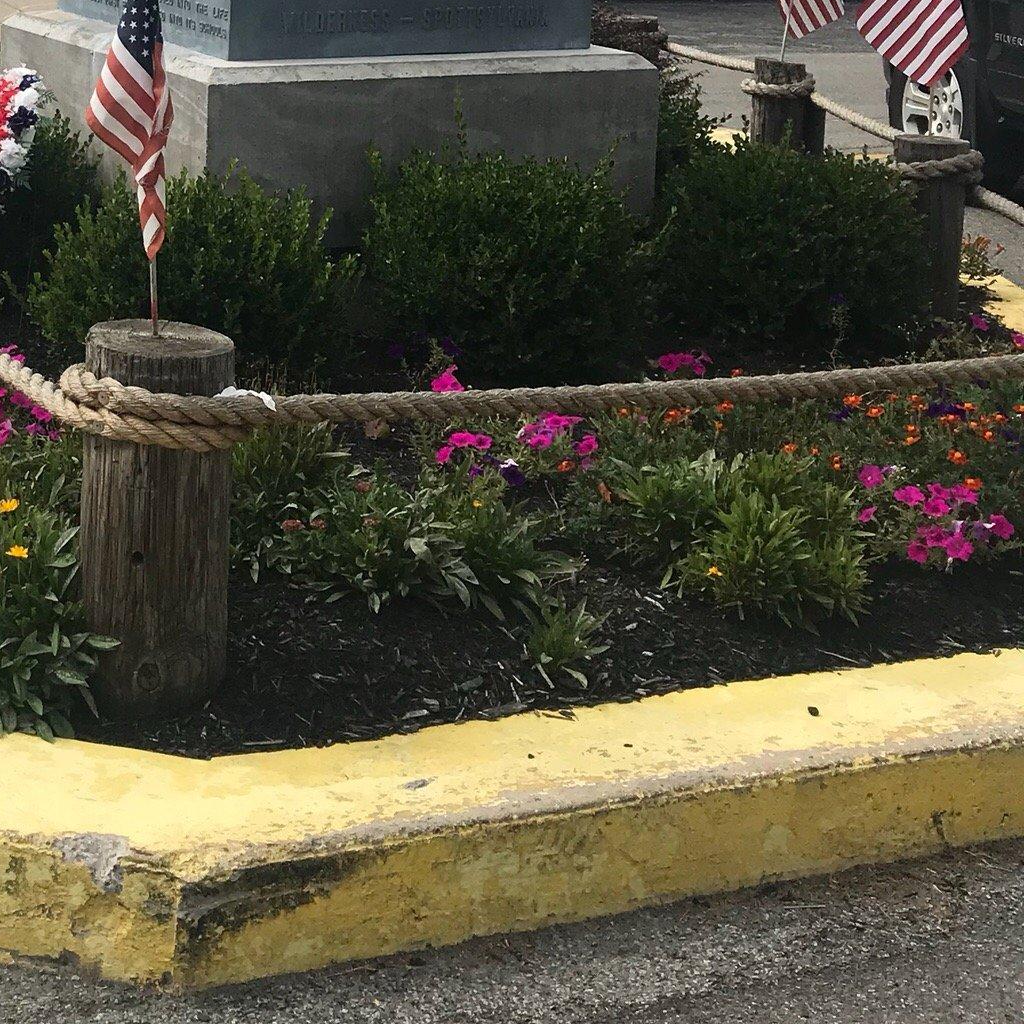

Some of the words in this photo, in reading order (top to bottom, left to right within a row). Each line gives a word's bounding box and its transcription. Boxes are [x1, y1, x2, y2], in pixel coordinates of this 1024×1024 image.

[196, 1, 209, 16] THE
[212, 6, 229, 22] LIFE
[994, 32, 1024, 47] SILVER
